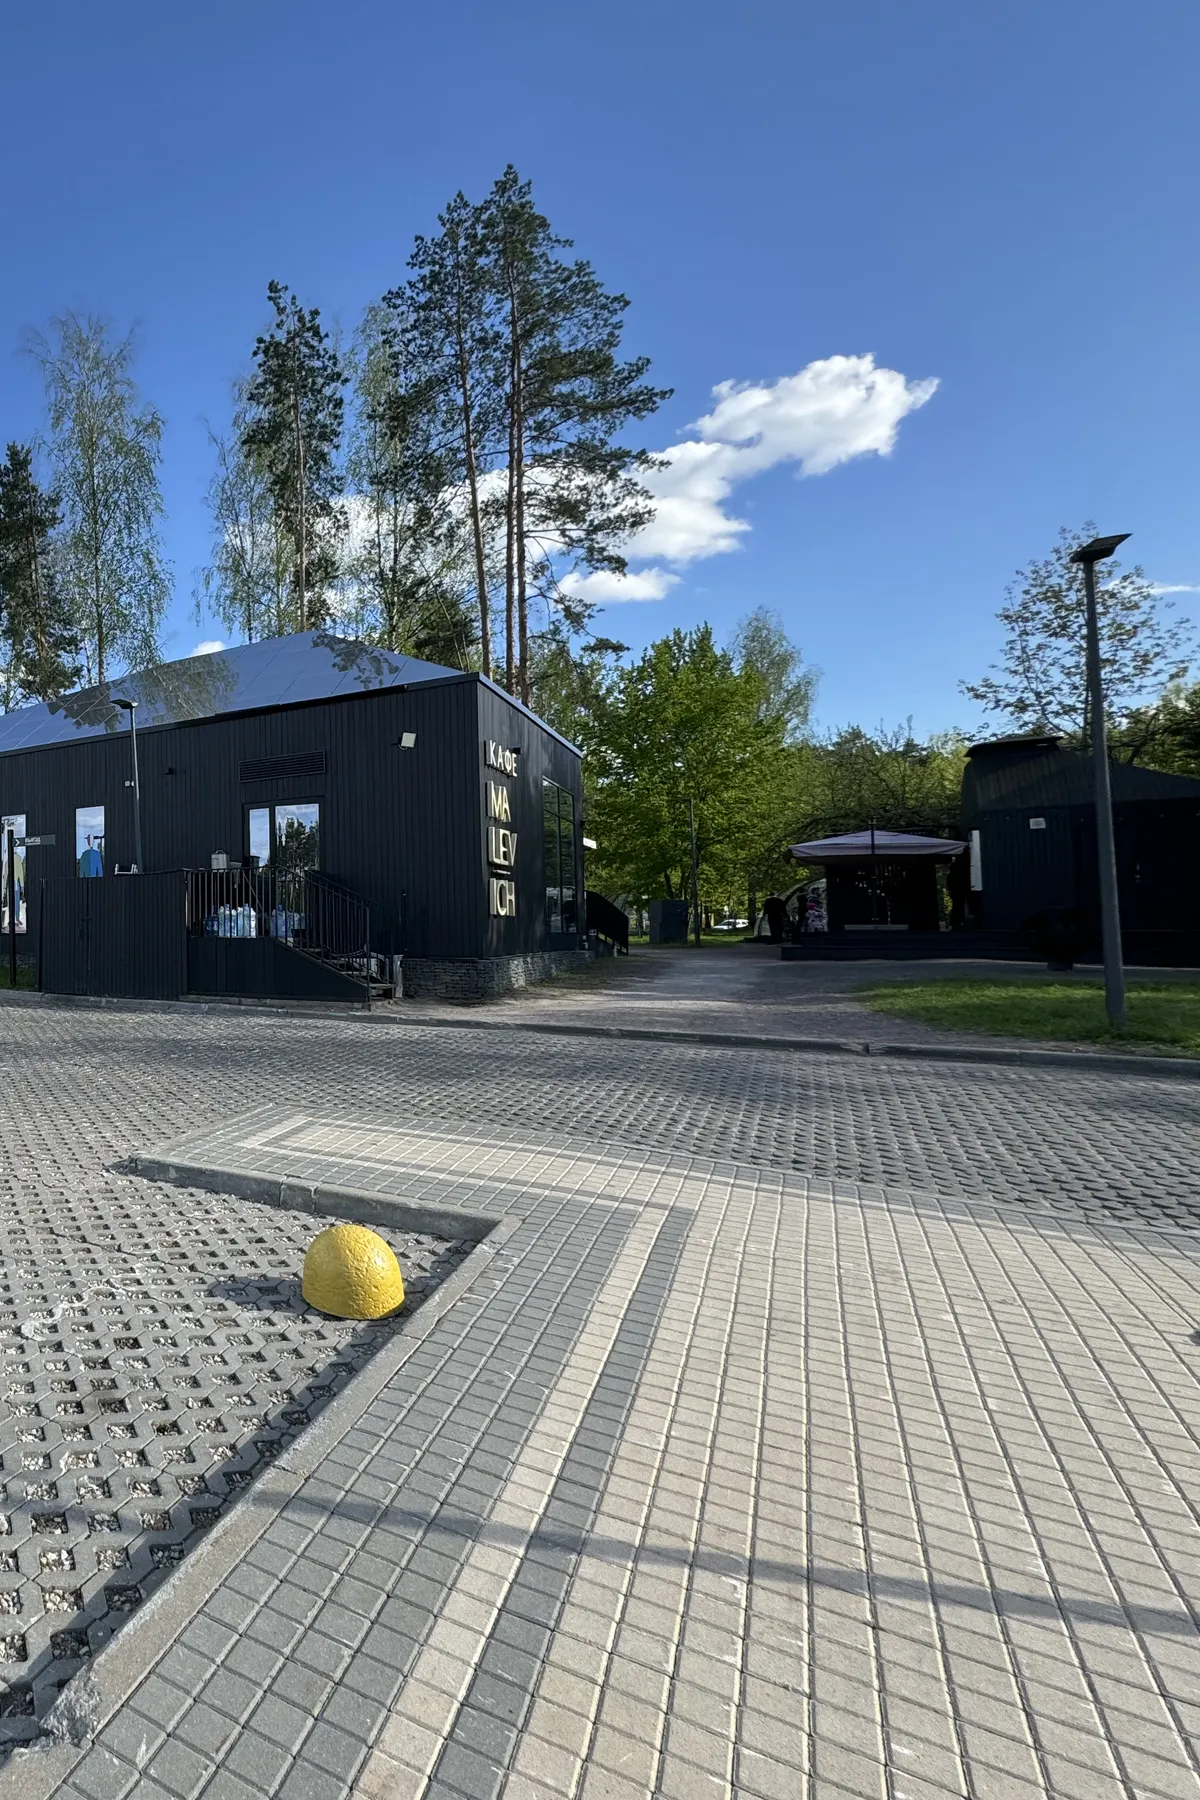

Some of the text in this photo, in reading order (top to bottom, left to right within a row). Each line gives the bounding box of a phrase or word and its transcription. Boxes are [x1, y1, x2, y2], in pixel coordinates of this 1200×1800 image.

[487, 740, 517, 777] КАФЕ
[488, 781, 511, 822] MA
[489, 827, 517, 866] LEV
[490, 878, 515, 916] ICH
